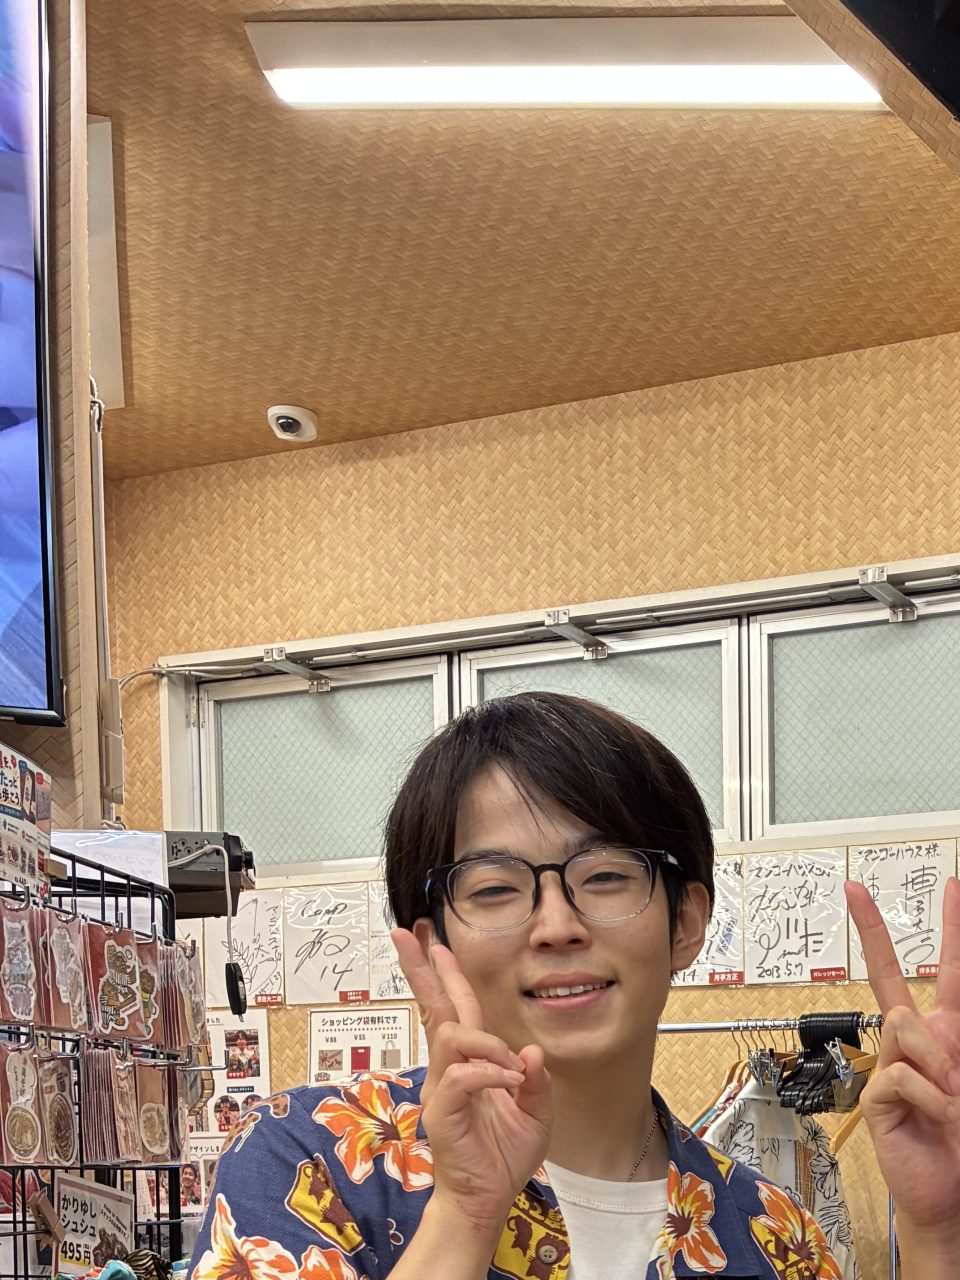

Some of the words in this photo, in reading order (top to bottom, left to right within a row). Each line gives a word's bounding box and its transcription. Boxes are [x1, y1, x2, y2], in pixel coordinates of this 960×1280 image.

[321, 1016, 398, 1026] ショッピング袋有料です
[62, 1195, 96, 1219] かりゆし
[61, 1214, 96, 1238] シュシュ
